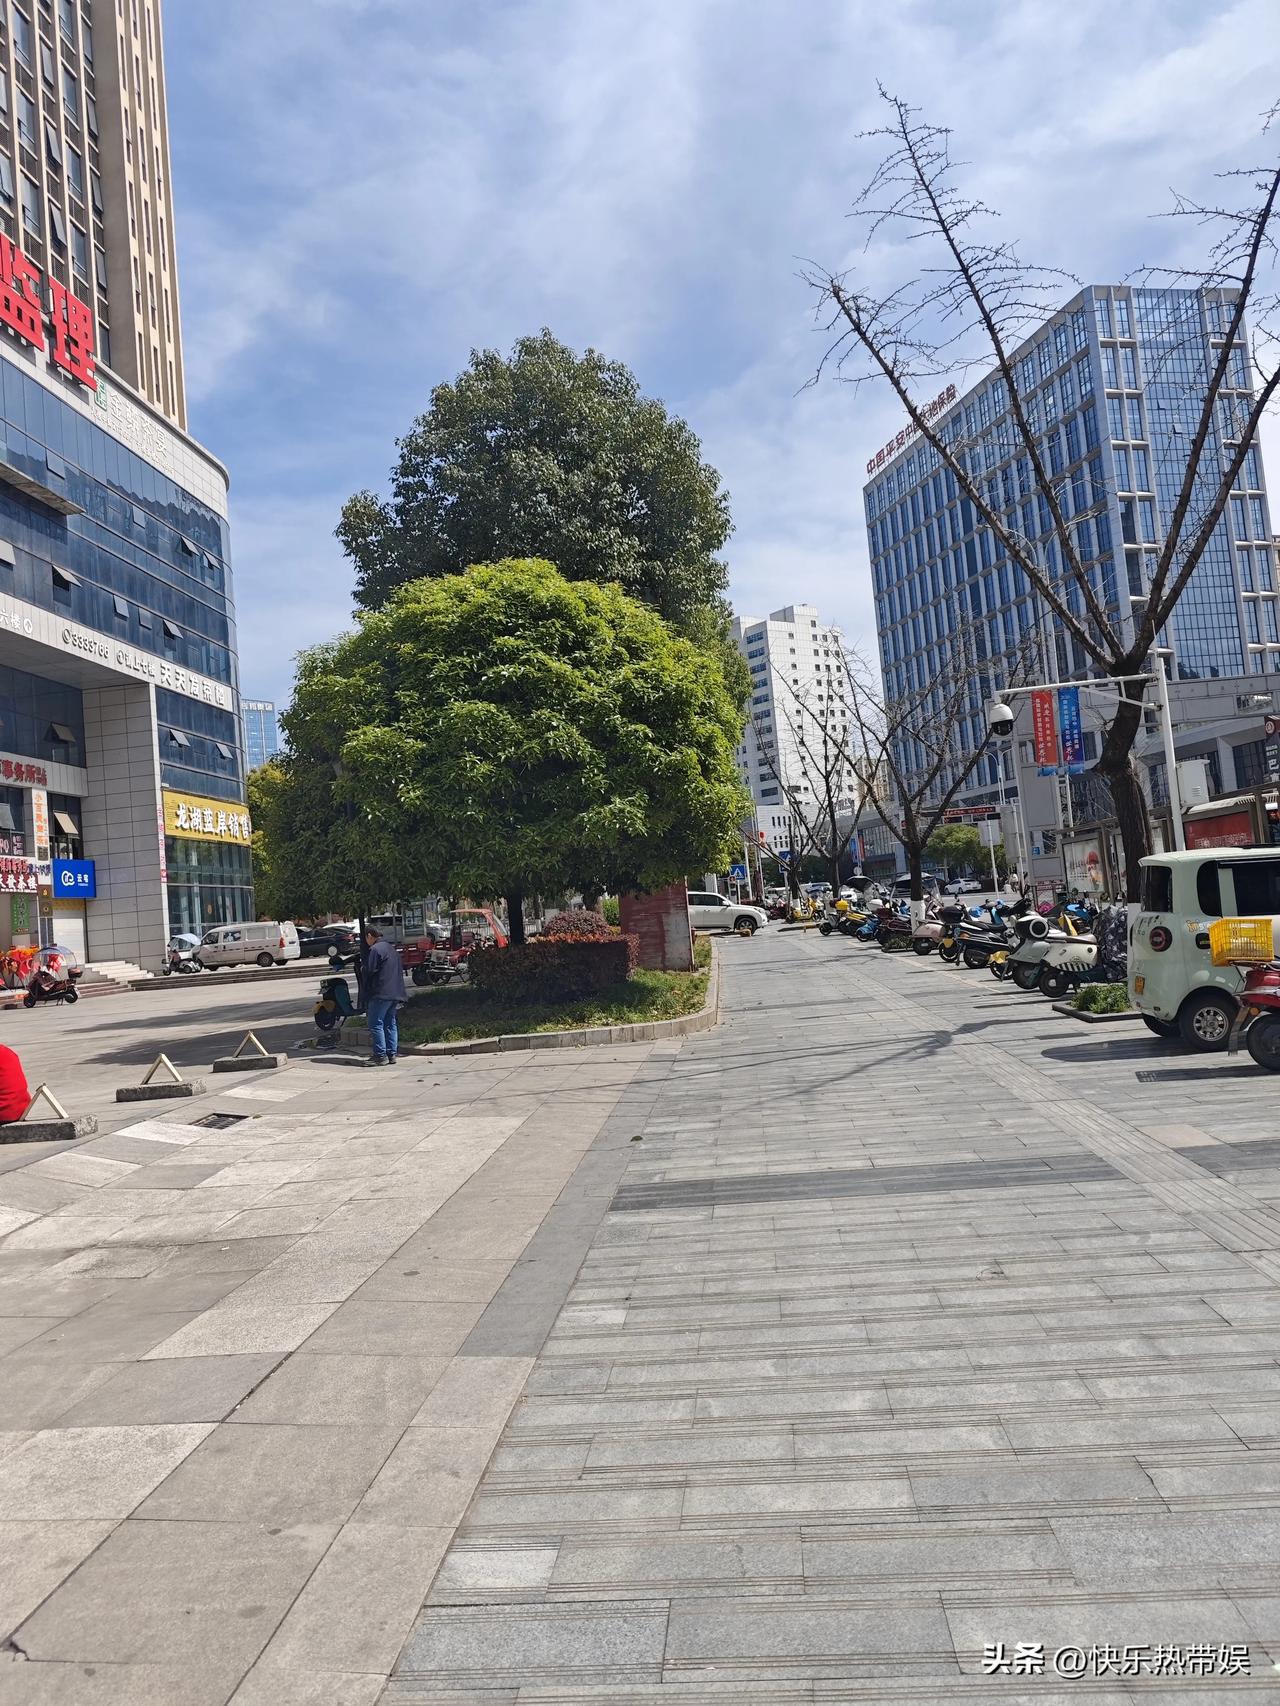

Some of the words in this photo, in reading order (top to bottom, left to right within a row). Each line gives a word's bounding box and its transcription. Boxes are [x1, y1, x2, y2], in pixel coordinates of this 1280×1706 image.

[0, 231, 97, 392] 监理
[71, 632, 110, 659] 3333766
[175, 802, 250, 840] 龙湖蓝岸销售
